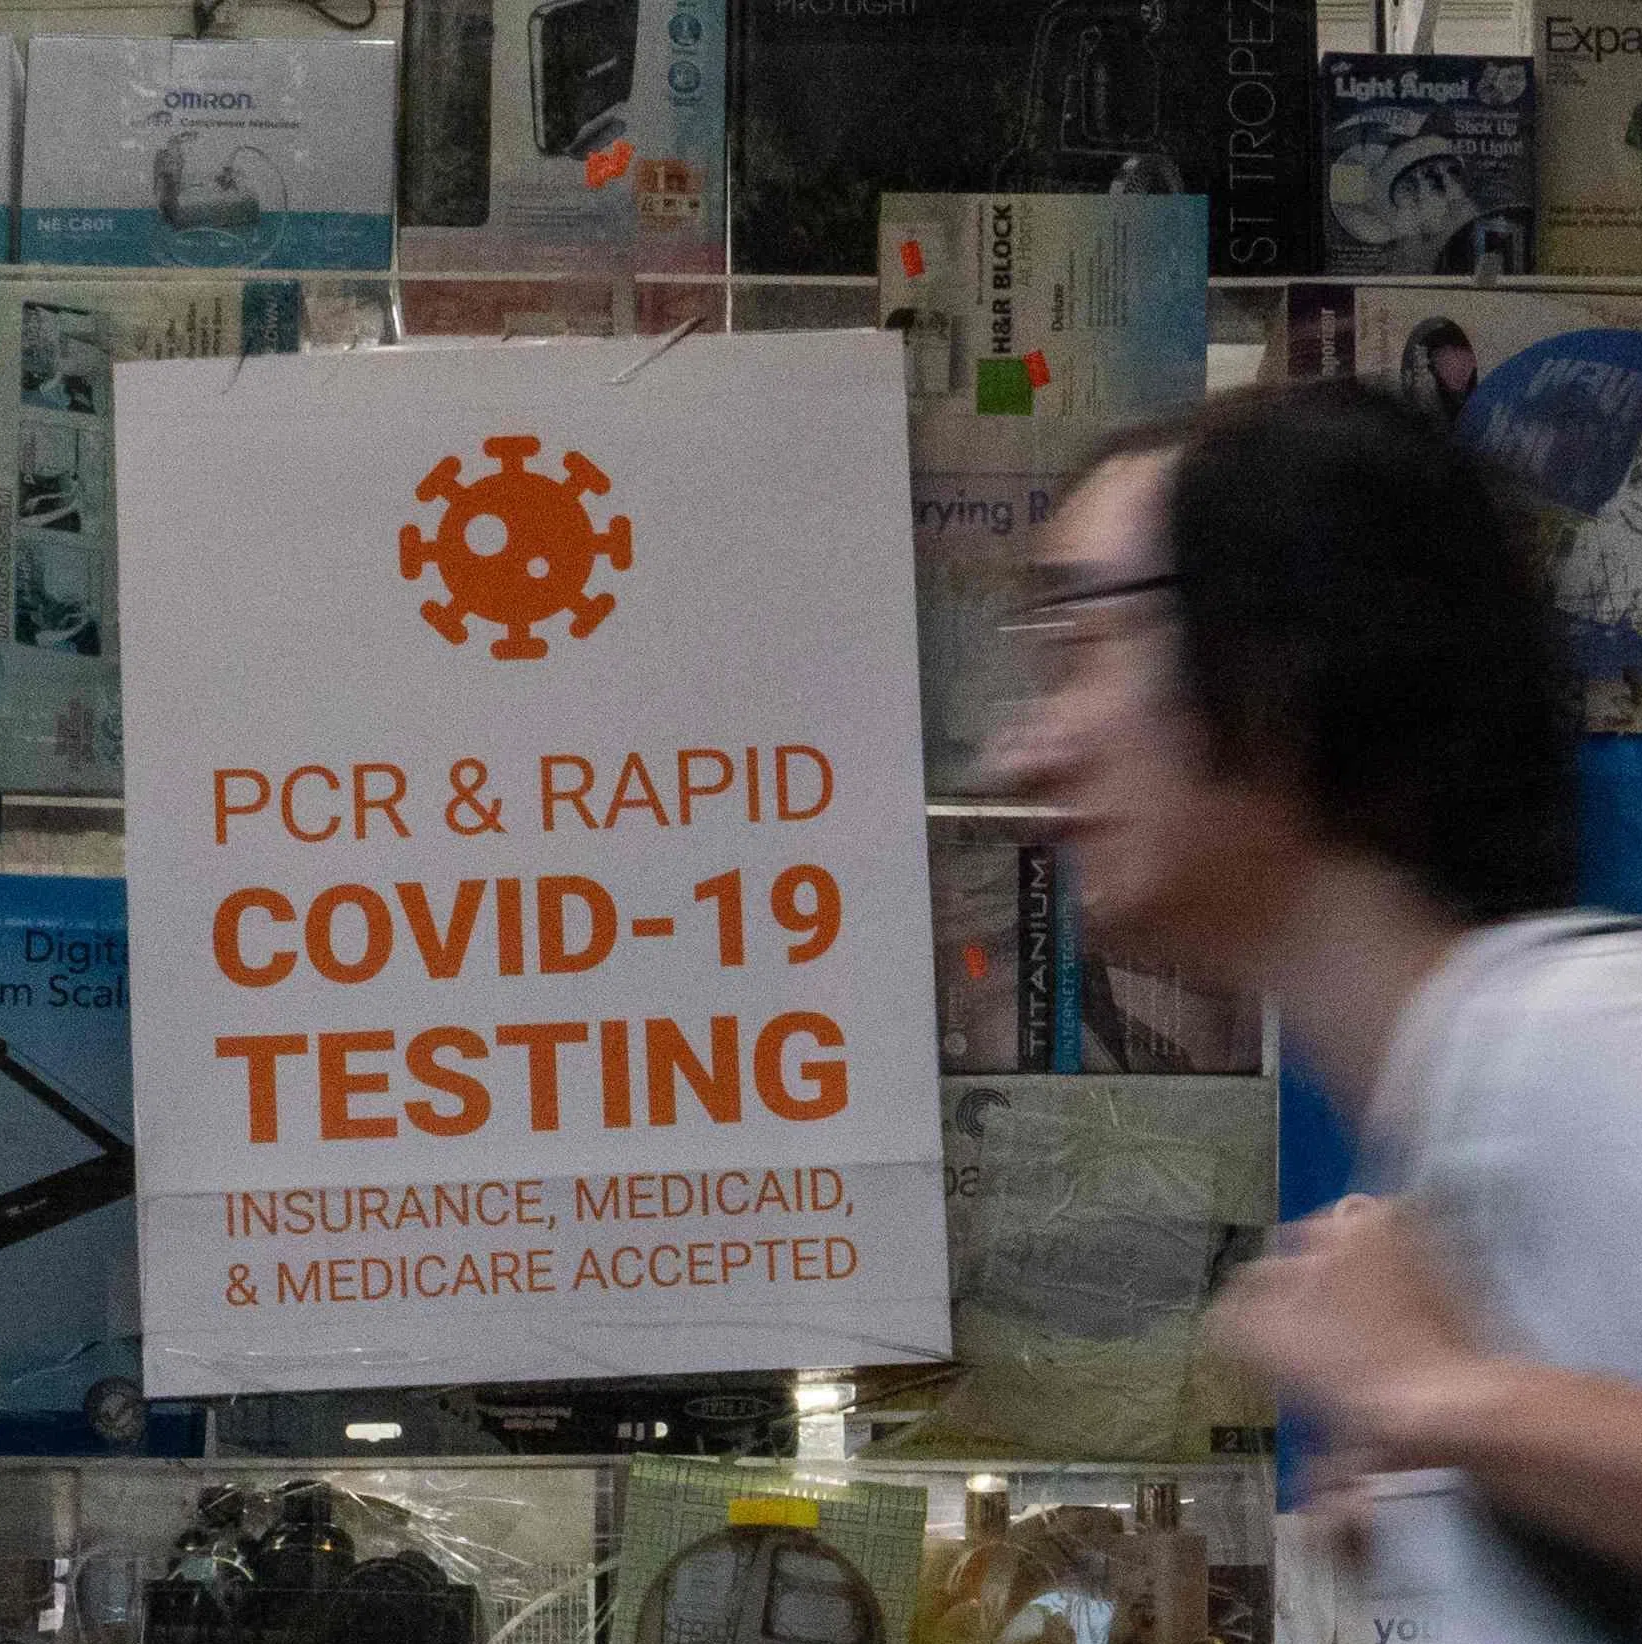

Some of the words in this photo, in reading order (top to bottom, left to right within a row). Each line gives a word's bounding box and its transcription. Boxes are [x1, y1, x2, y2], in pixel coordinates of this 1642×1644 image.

[163, 91, 253, 111] OMRON
[1335, 76, 1395, 100] Light
[1400, 70, 1469, 100] Angel
[992, 204, 1012, 289] BLOCK
[1229, 206, 1278, 265] ST
[992, 299, 1012, 354] H&R
[1051, 283, 1065, 332] Deluxe
[213, 762, 412, 845] PCR
[443, 758, 507, 836] &
[538, 745, 834, 831] RAPID
[212, 864, 843, 988] COVID-19
[1028, 857, 1048, 1058] TITANIUM
[47, 975, 128, 1010] Scal
[215, 1011, 849, 1144] TESTING
[226, 1178, 557, 1238] INSURANCE,
[573, 1167, 855, 1221] MEDICAID,
[225, 1262, 259, 1307] &
[276, 1248, 556, 1304] MEDICARE
[572, 1237, 858, 1292] ACCEPTED
